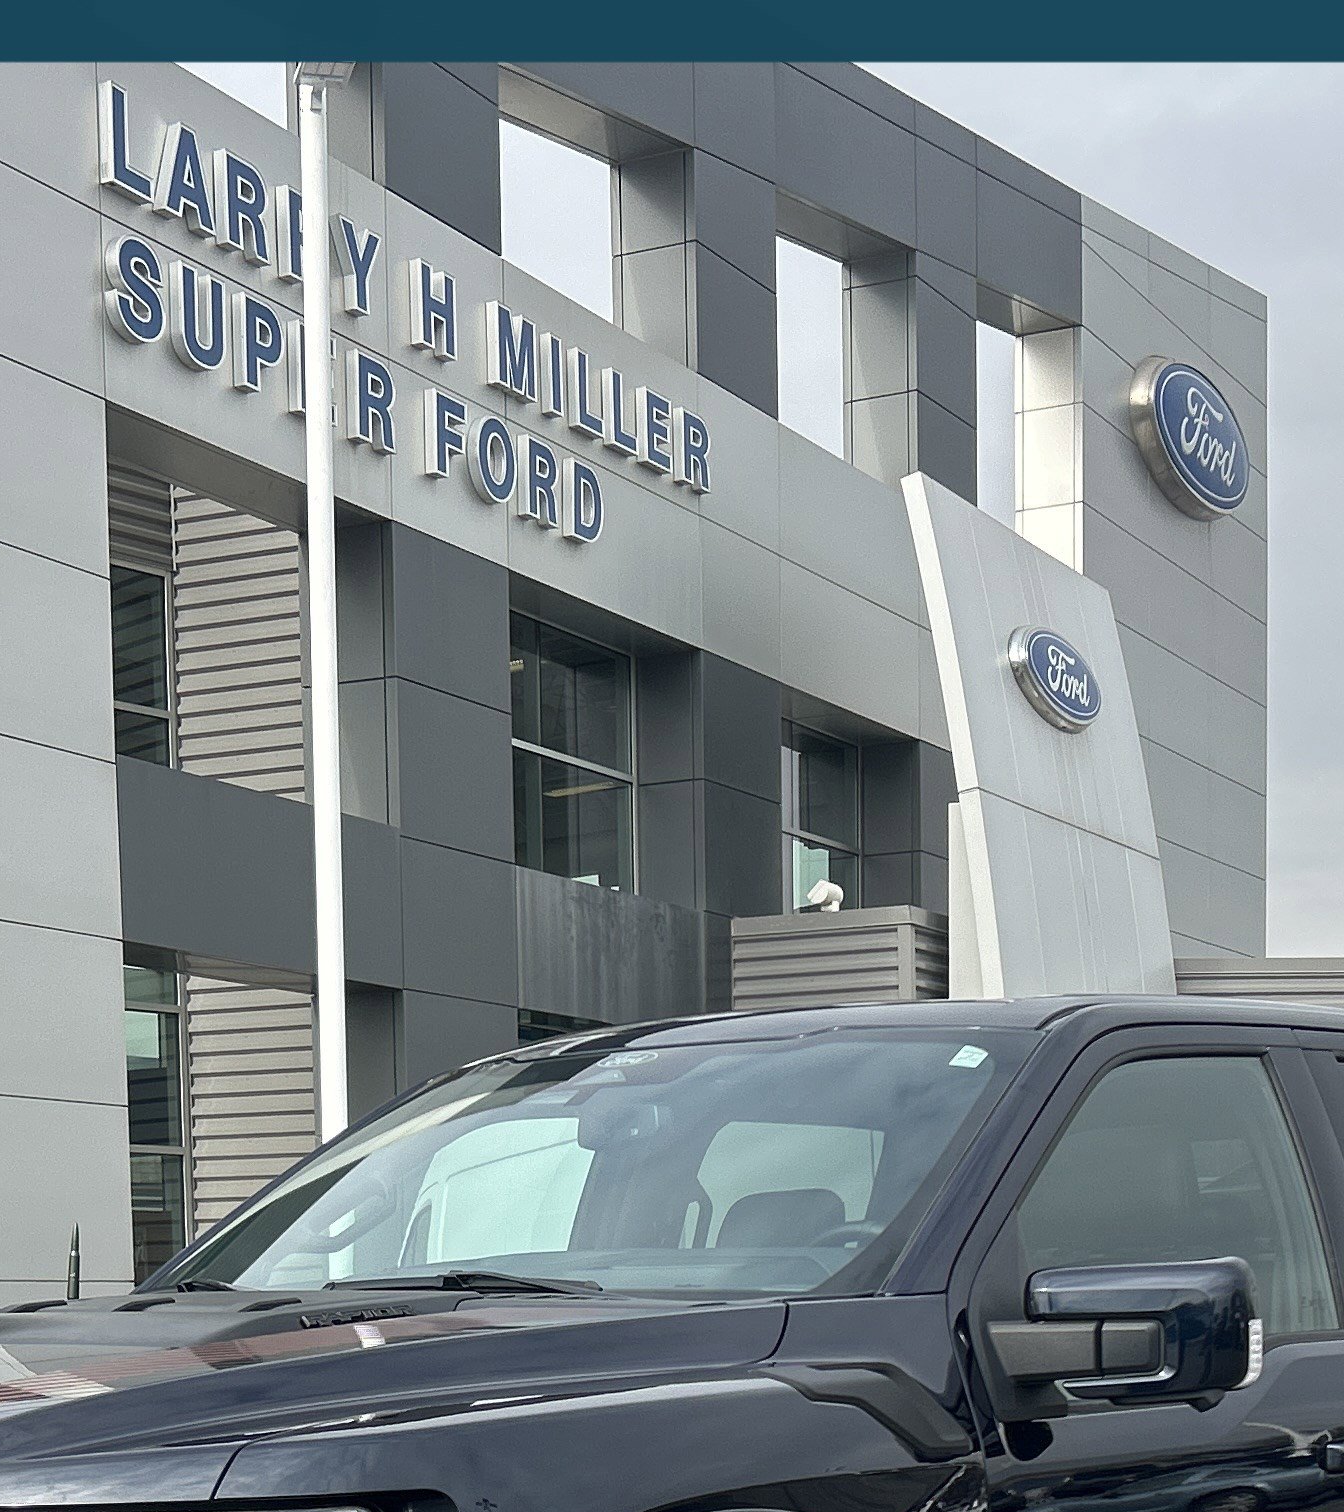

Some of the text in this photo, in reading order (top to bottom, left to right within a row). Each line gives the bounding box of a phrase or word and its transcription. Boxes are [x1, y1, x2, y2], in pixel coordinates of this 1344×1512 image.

[409, 257, 457, 363] H
[486, 300, 711, 495] MILLER
[1180, 385, 1237, 489] Ford
[425, 387, 604, 543] FORD
[1046, 644, 1091, 708] Ford
